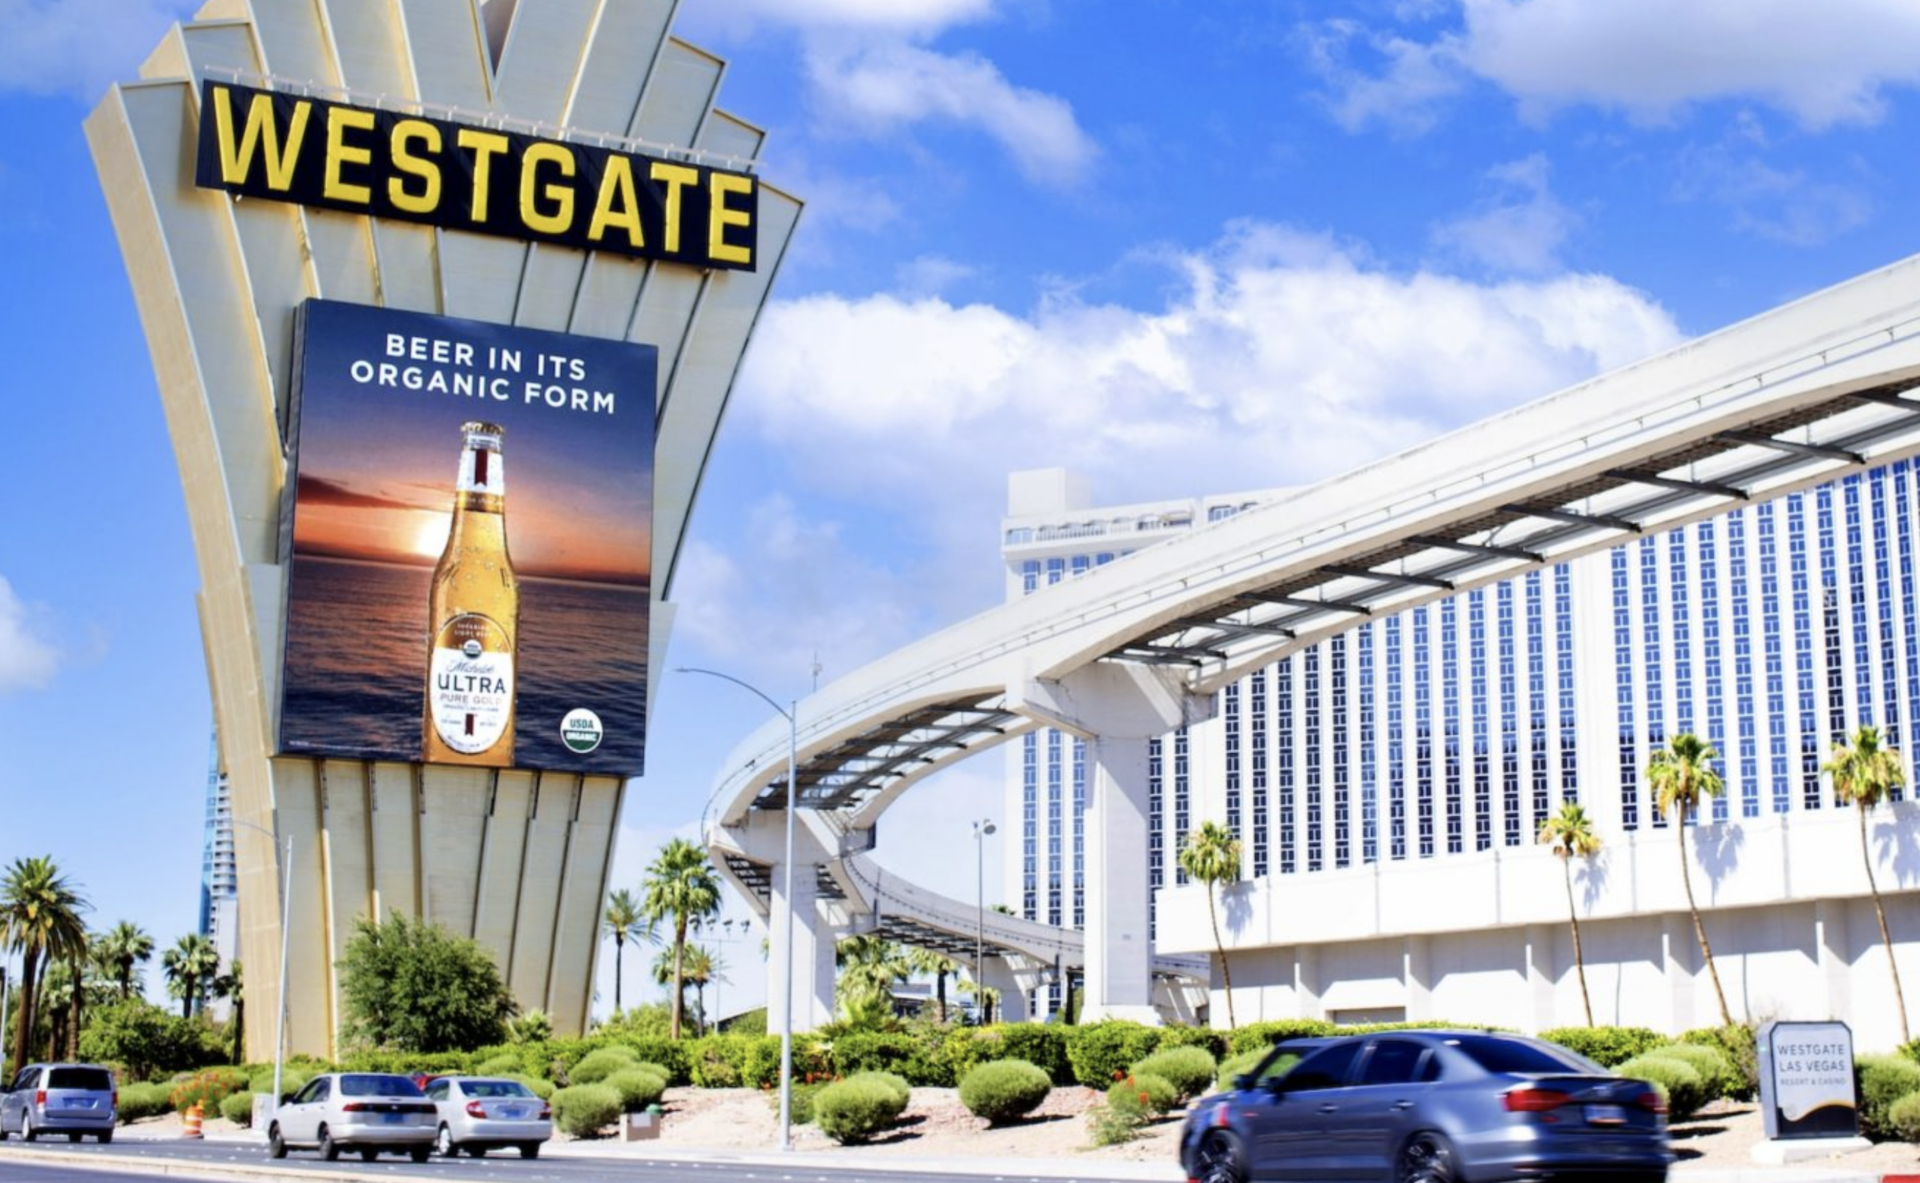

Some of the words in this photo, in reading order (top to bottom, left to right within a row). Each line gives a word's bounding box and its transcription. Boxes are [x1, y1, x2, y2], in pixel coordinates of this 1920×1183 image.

[213, 86, 752, 264] WESTGATE
[386, 333, 474, 367] BEER
[489, 347, 521, 372] IN
[537, 354, 586, 381] ITS
[350, 360, 510, 401] ORGANIC
[524, 382, 615, 415] FORM
[438, 673, 506, 694] ULTRA
[440, 693, 469, 703] PURE
[473, 695, 503, 706] GOLD
[569, 718, 594, 729] USDA
[1777, 1044, 1845, 1055] WESTGATE
[1779, 1061, 1802, 1072] LAS
[1806, 1060, 1845, 1072] VEGAS
